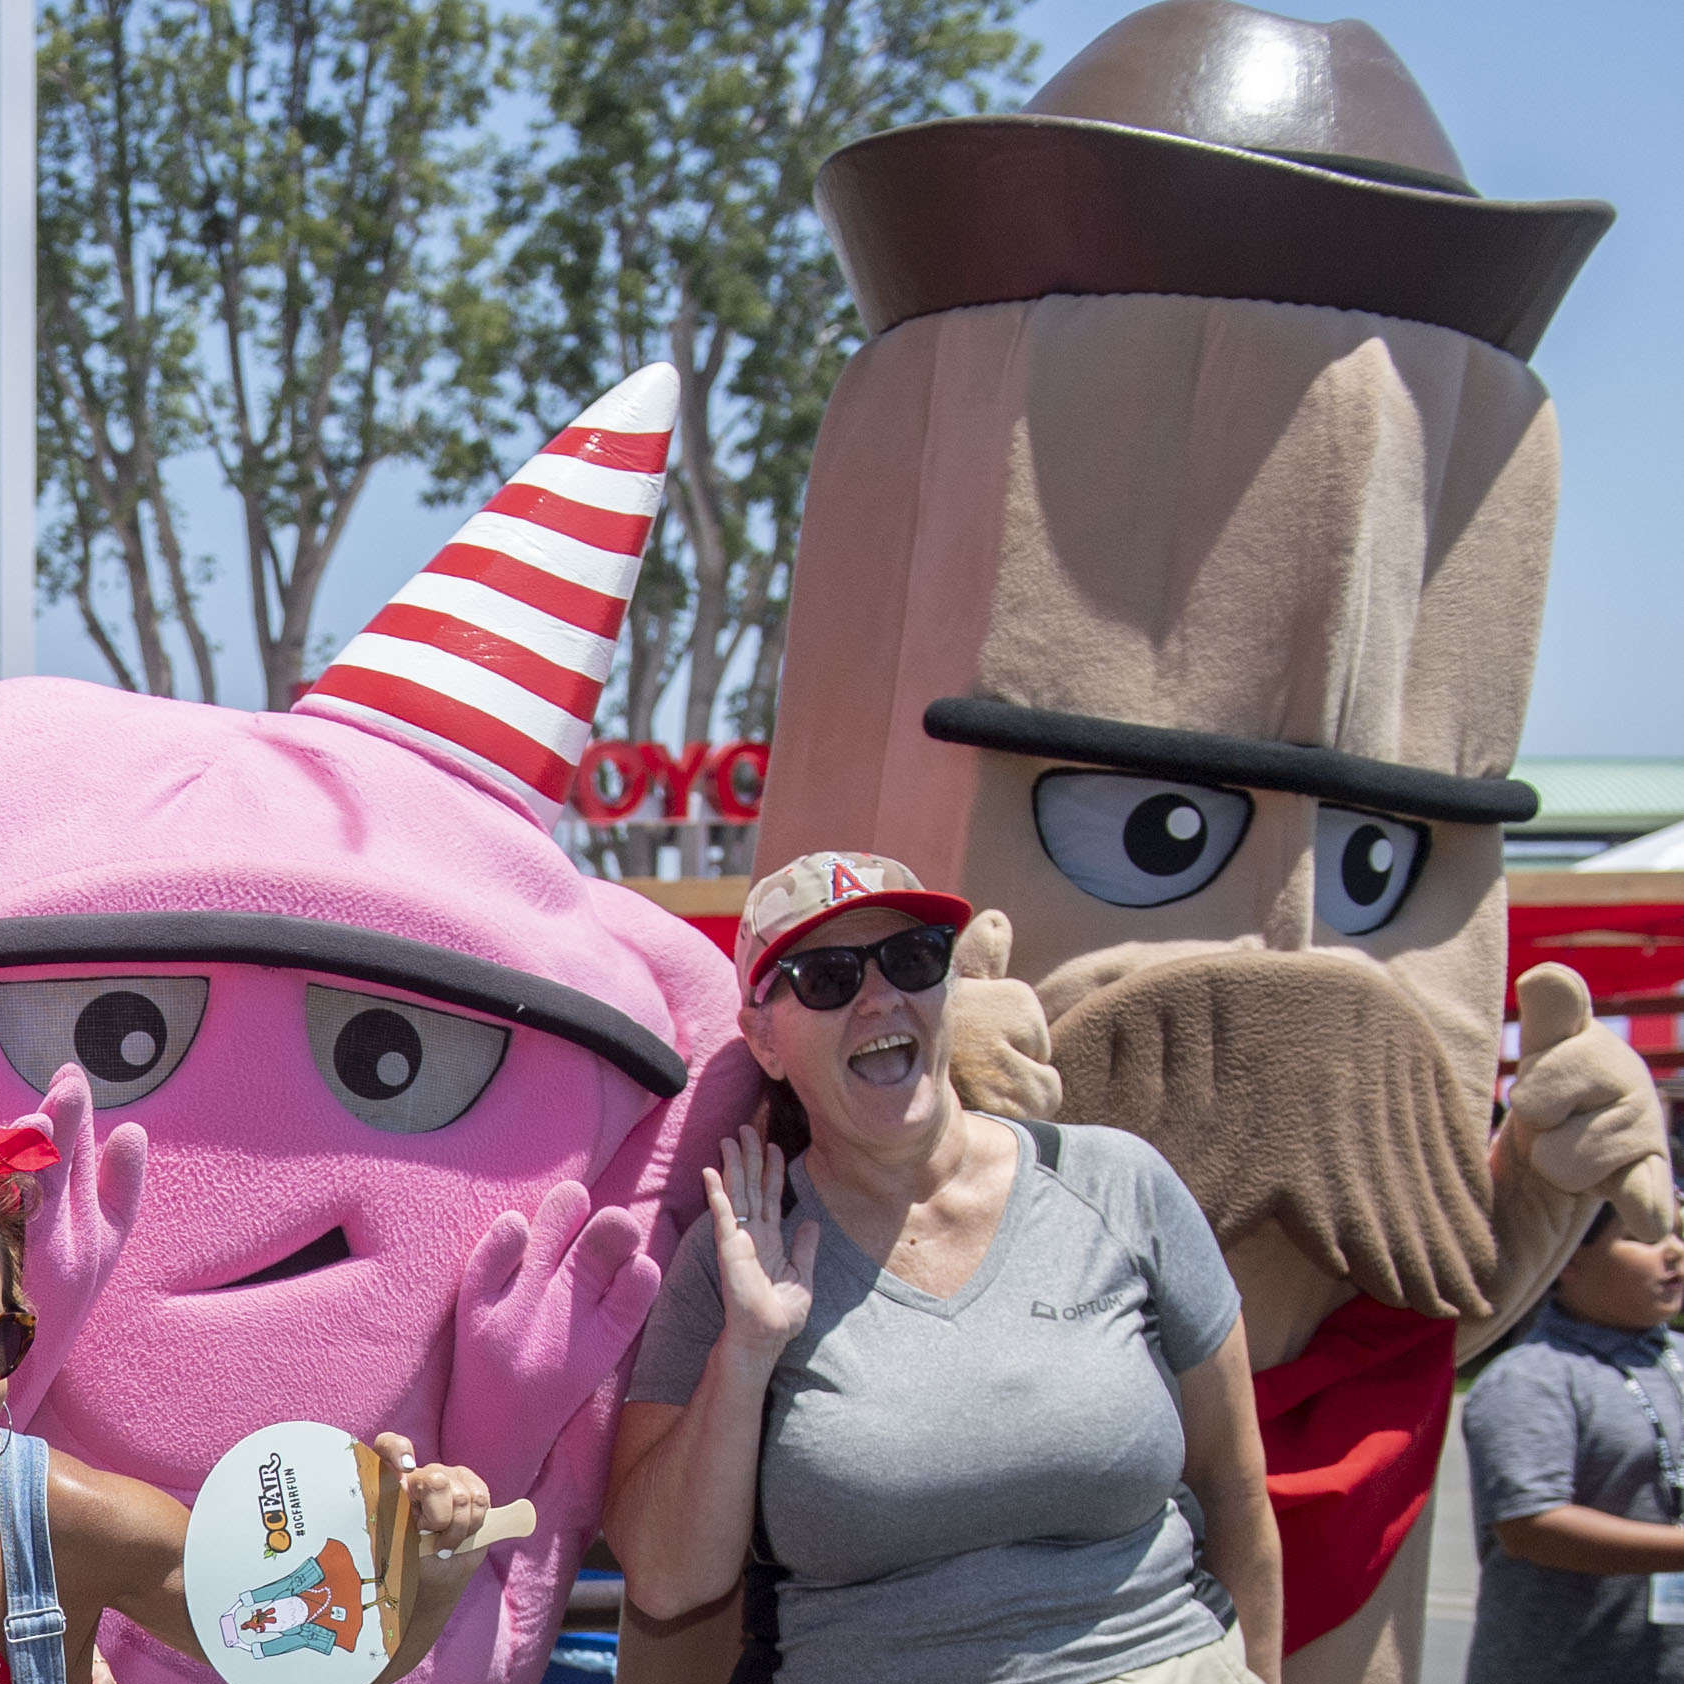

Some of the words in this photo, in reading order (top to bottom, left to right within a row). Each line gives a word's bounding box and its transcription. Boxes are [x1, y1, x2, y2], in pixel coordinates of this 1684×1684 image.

[576, 739, 770, 824] OYO
[830, 860, 874, 903] A
[1062, 1294, 1122, 1321] OPTUM
[284, 1468, 305, 1536] #OCFAIRFUN
